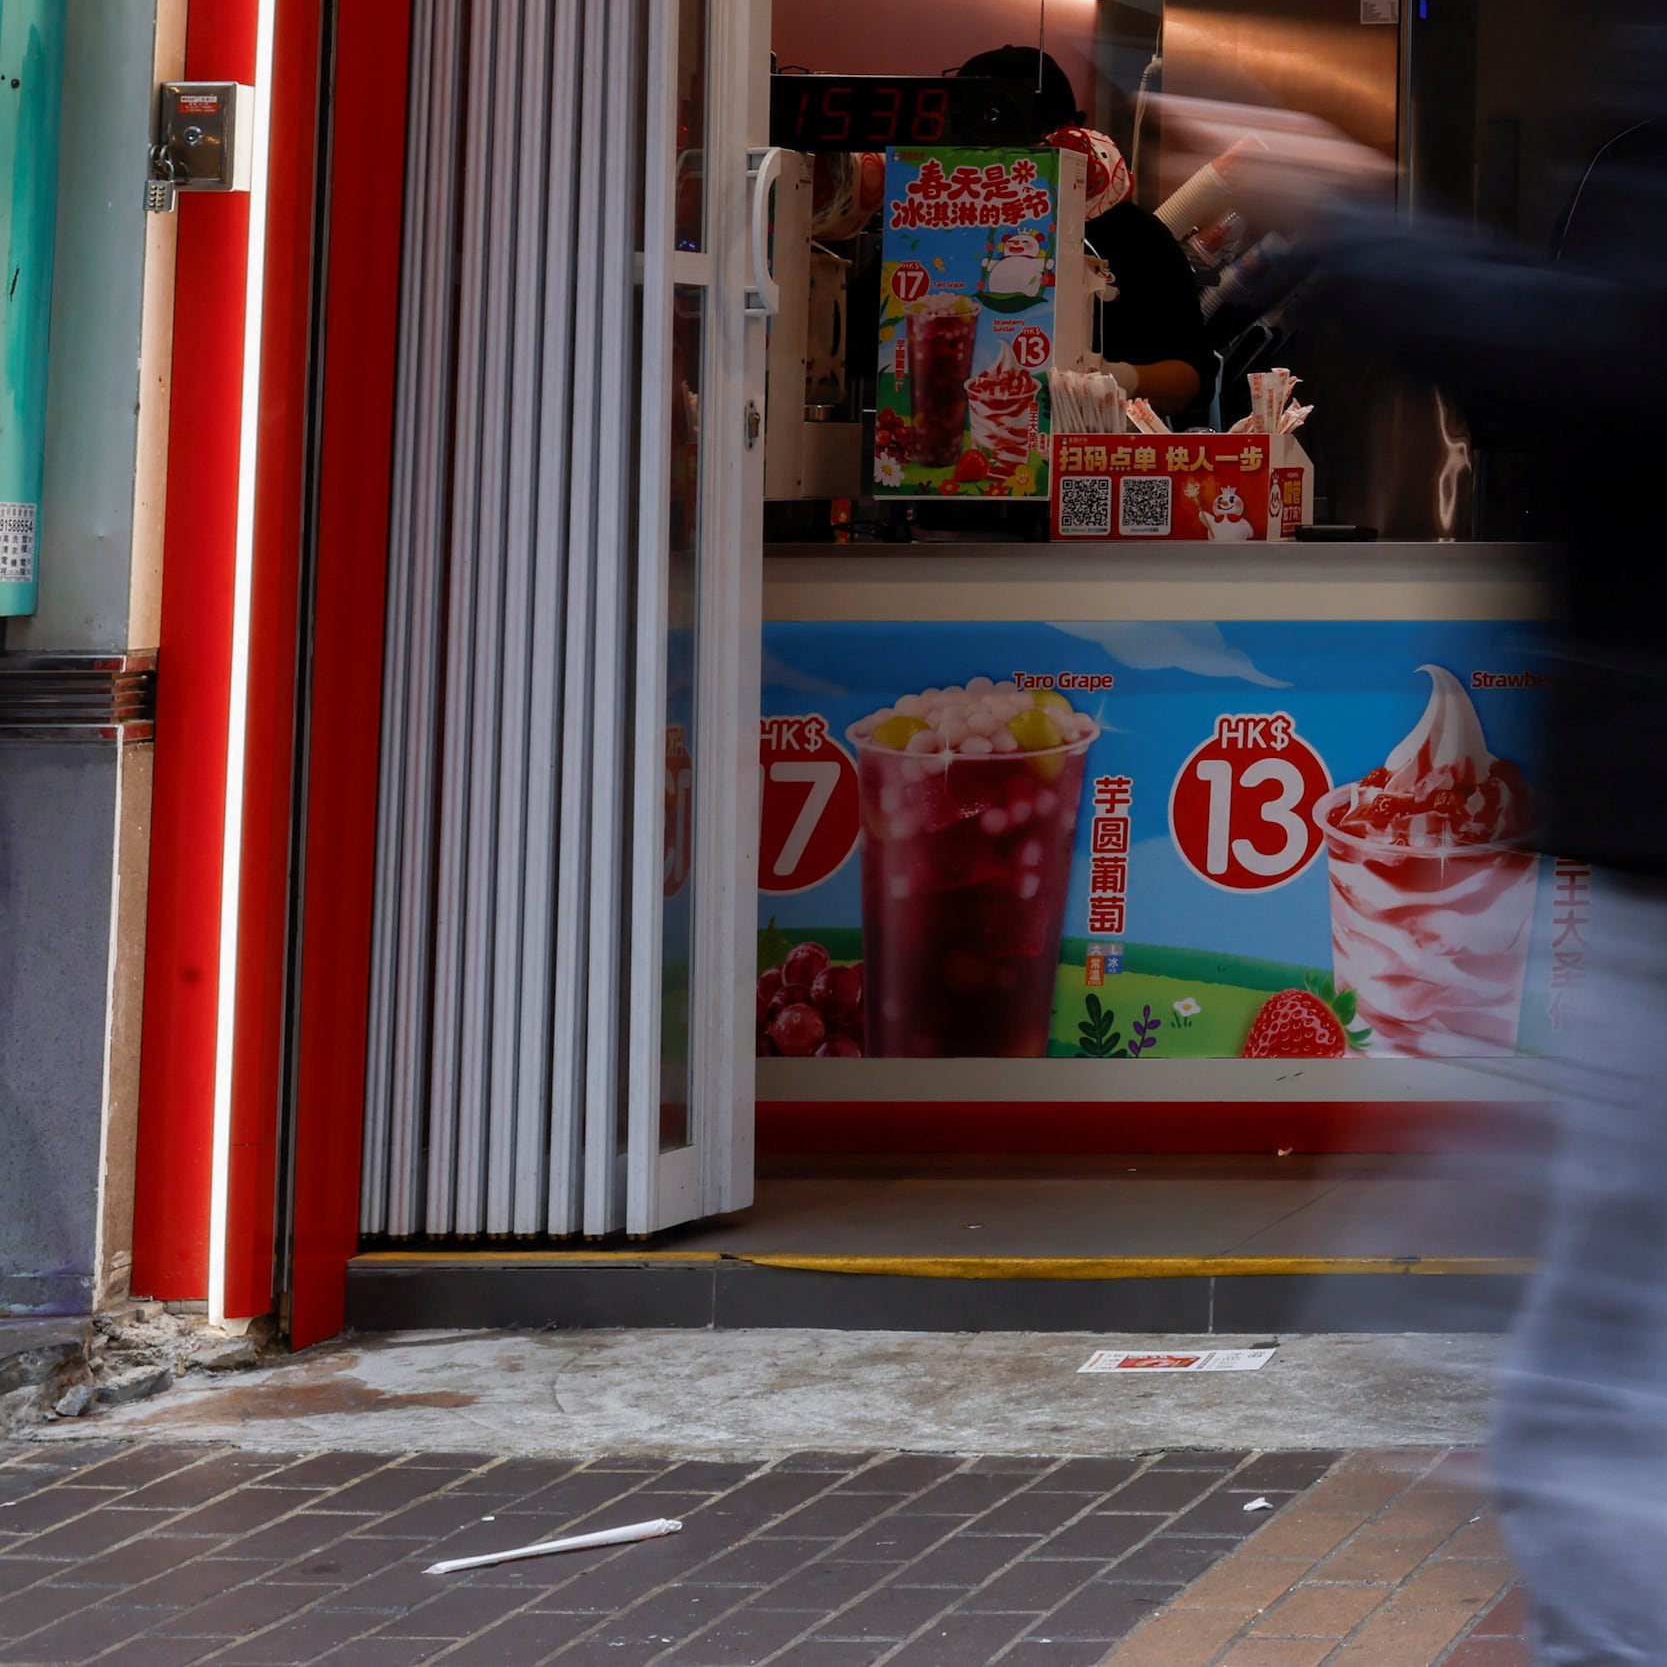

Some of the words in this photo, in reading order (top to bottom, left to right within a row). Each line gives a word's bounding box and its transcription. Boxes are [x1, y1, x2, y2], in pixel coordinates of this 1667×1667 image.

[908, 159, 1019, 201] 春天是
[892, 190, 1049, 228] 冰淇淋的季节
[897, 271, 924, 299] 17
[1017, 336, 1045, 365] 13
[1059, 446, 1157, 472] 扫码点单
[1166, 446, 1264, 472] 快人一步
[1014, 670, 1055, 690] Taro
[1057, 671, 1113, 693] Grape
[1222, 714, 1293, 752] HK$
[1197, 758, 1307, 877] 13
[1089, 776, 1131, 934] 芋圆葡萄
